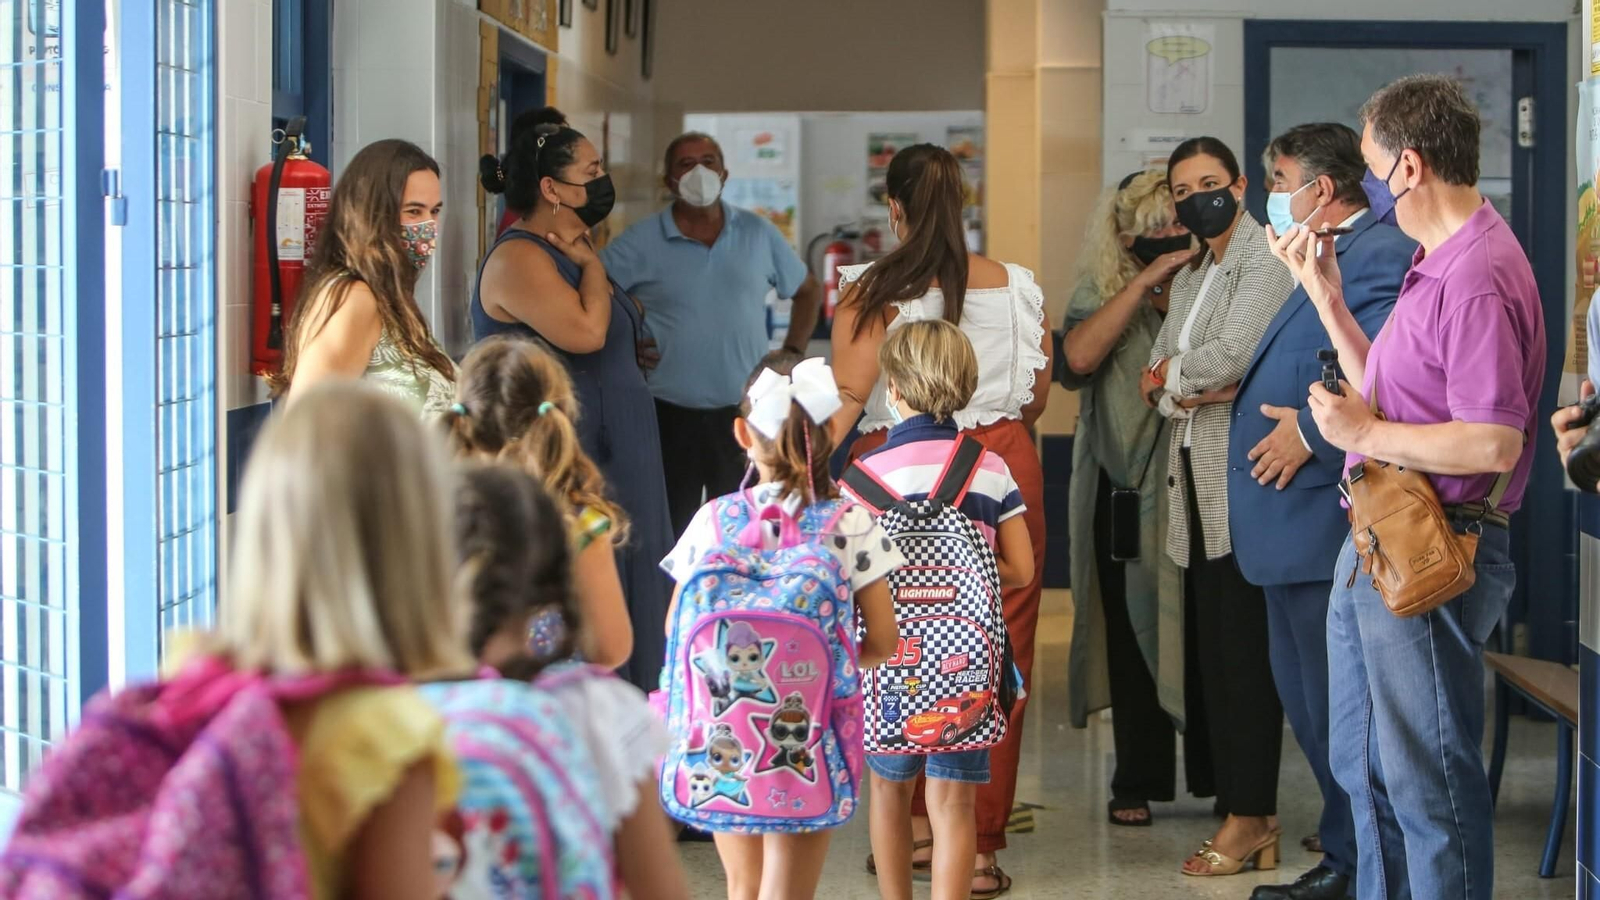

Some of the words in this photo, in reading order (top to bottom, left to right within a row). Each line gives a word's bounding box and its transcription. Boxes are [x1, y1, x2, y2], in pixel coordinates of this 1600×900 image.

[900, 588, 954, 598] LIGHTNING
[887, 636, 922, 667] 95
[781, 661, 819, 677] LOL
[954, 674, 987, 684] RACER
[887, 702, 896, 711] 7
